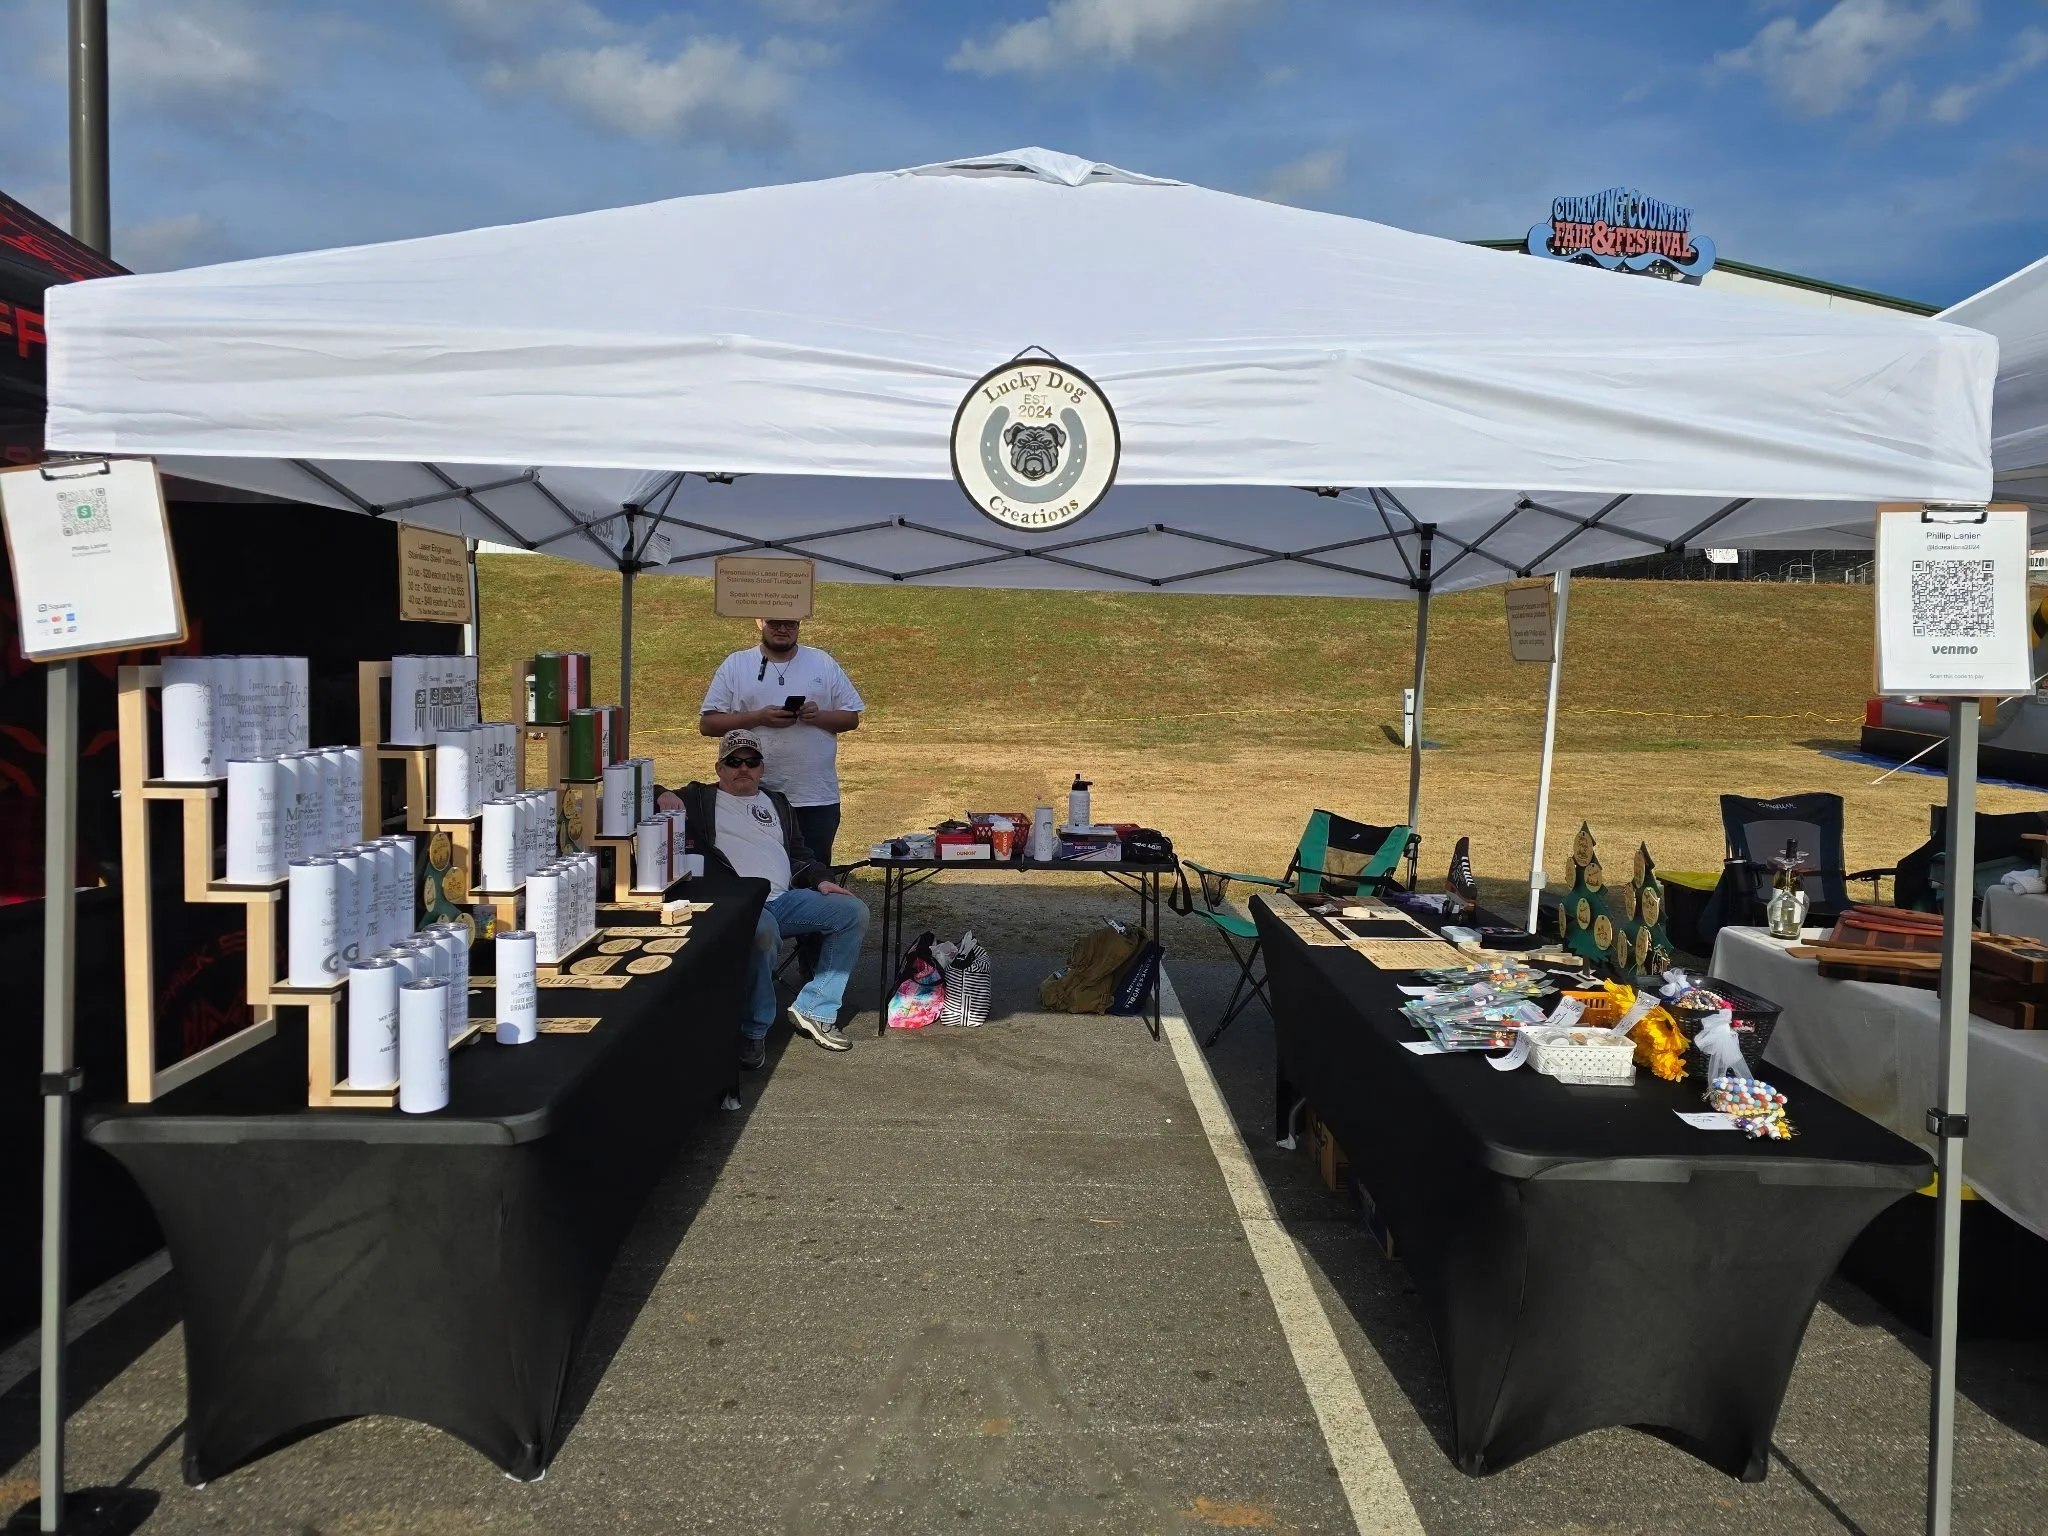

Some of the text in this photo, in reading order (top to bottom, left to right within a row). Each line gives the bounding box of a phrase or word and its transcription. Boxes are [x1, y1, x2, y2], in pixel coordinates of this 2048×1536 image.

[1553, 187, 1694, 231] CUMMING COUNTRY
[982, 371, 1087, 404] Lucky Dog
[1024, 394, 1049, 405] EST
[1018, 405, 1053, 419] 2024
[989, 495, 1079, 524] Creations
[1926, 531, 1981, 541] Phillip Lanier
[729, 591, 749, 599] Speak
[764, 592, 780, 600] Kelly
[1932, 645, 1978, 655] venmo
